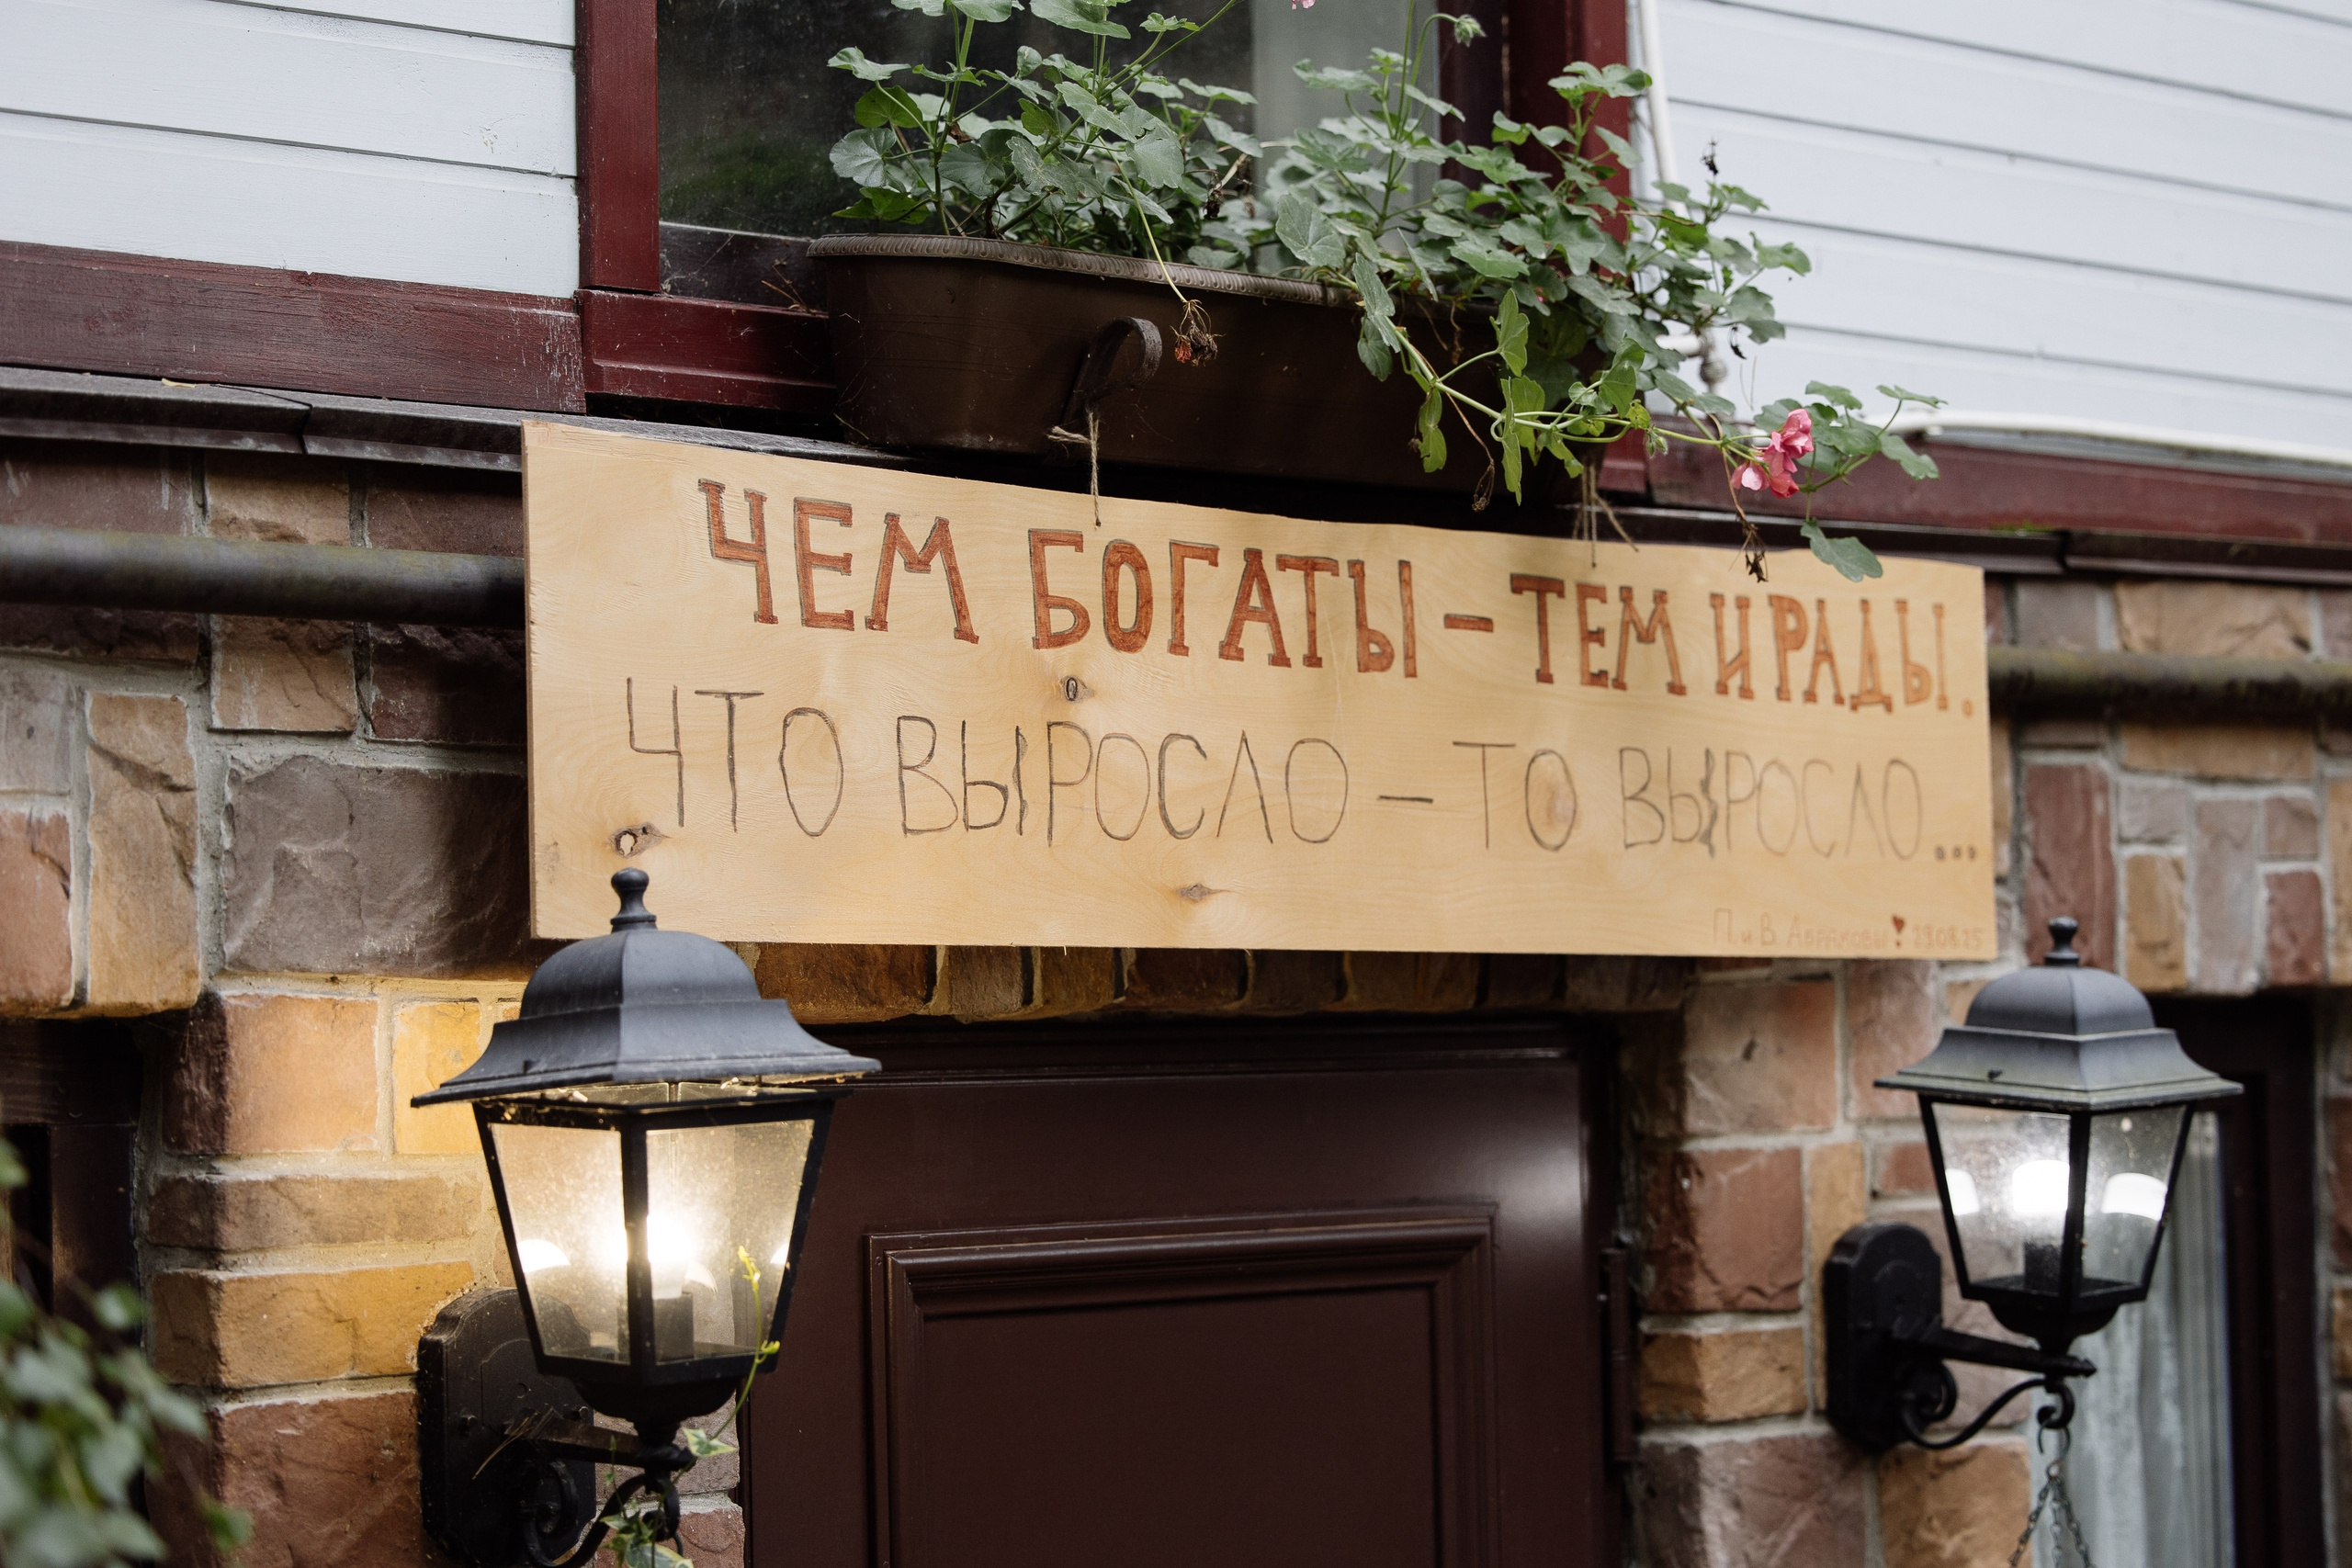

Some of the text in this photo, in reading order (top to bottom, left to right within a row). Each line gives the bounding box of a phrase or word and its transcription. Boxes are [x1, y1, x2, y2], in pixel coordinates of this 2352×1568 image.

[698, 479, 979, 644] ЧЕМ
[1028, 528, 1419, 678] БОГАТЫ
[1510, 572, 1687, 696] ТЕМ
[1709, 592, 1755, 701] И
[627, 676, 843, 837] ЧТО
[896, 713, 1349, 847] ВЫРОСЛО
[1453, 740, 1577, 852] ТО
